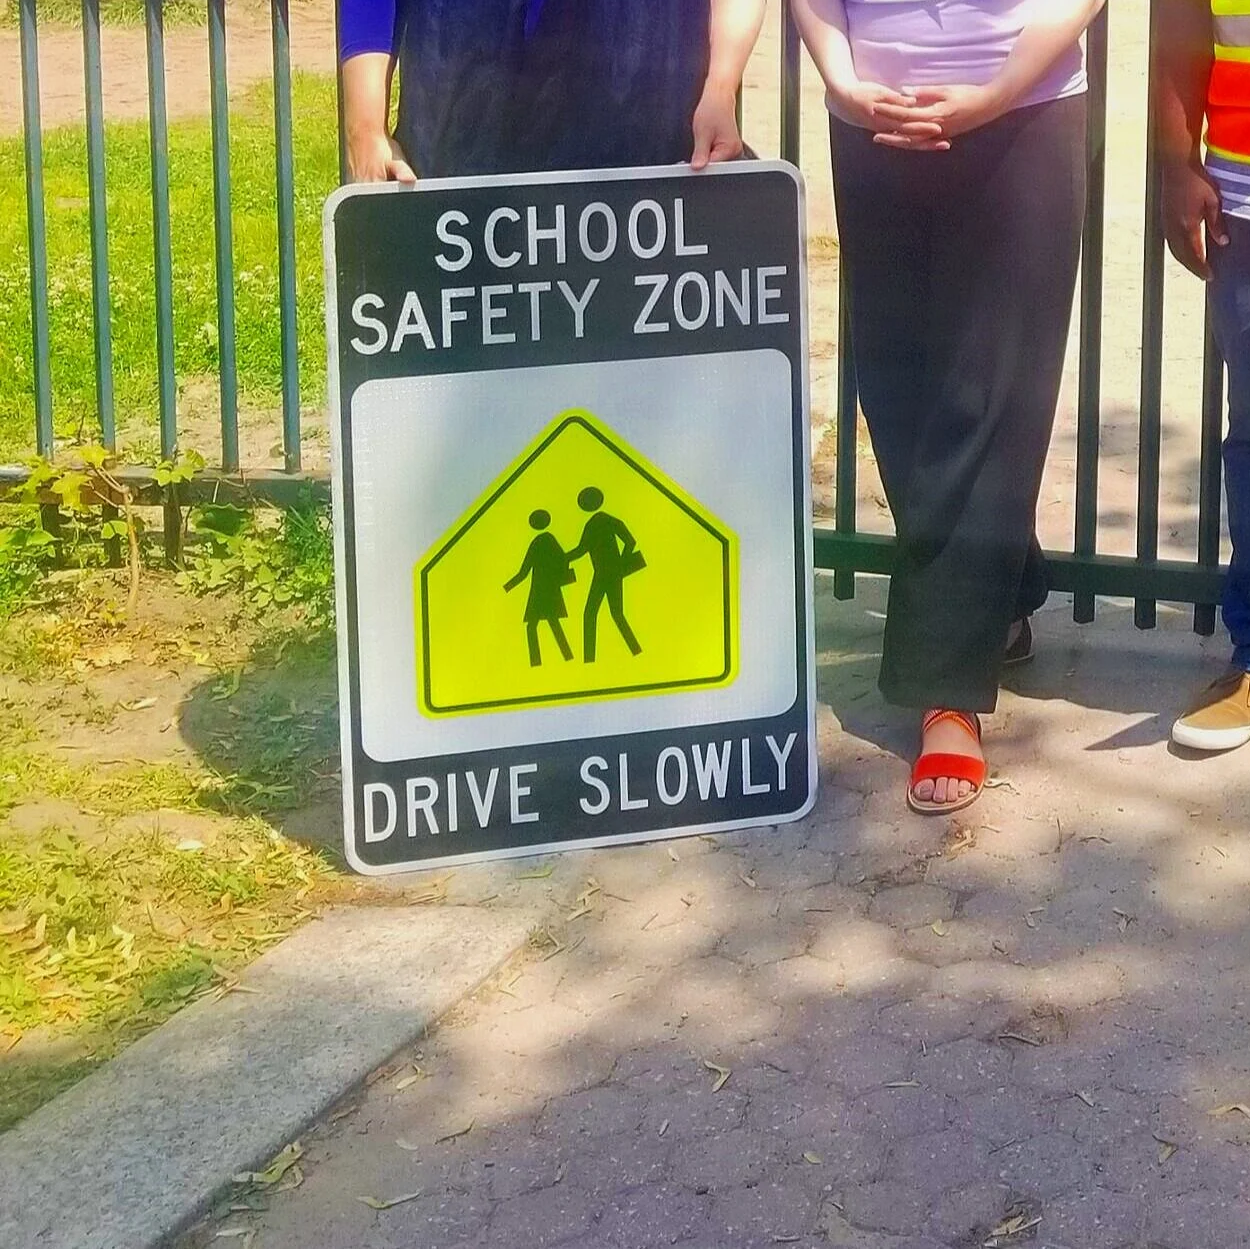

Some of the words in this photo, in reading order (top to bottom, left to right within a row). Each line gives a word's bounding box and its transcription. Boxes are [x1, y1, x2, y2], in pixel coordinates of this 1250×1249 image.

[435, 198, 709, 271] SCHOOL
[350, 278, 600, 355] SAFETY
[633, 266, 790, 334] ZONE
[362, 763, 540, 843] DRIVE
[579, 732, 798, 815] SLOWLY
